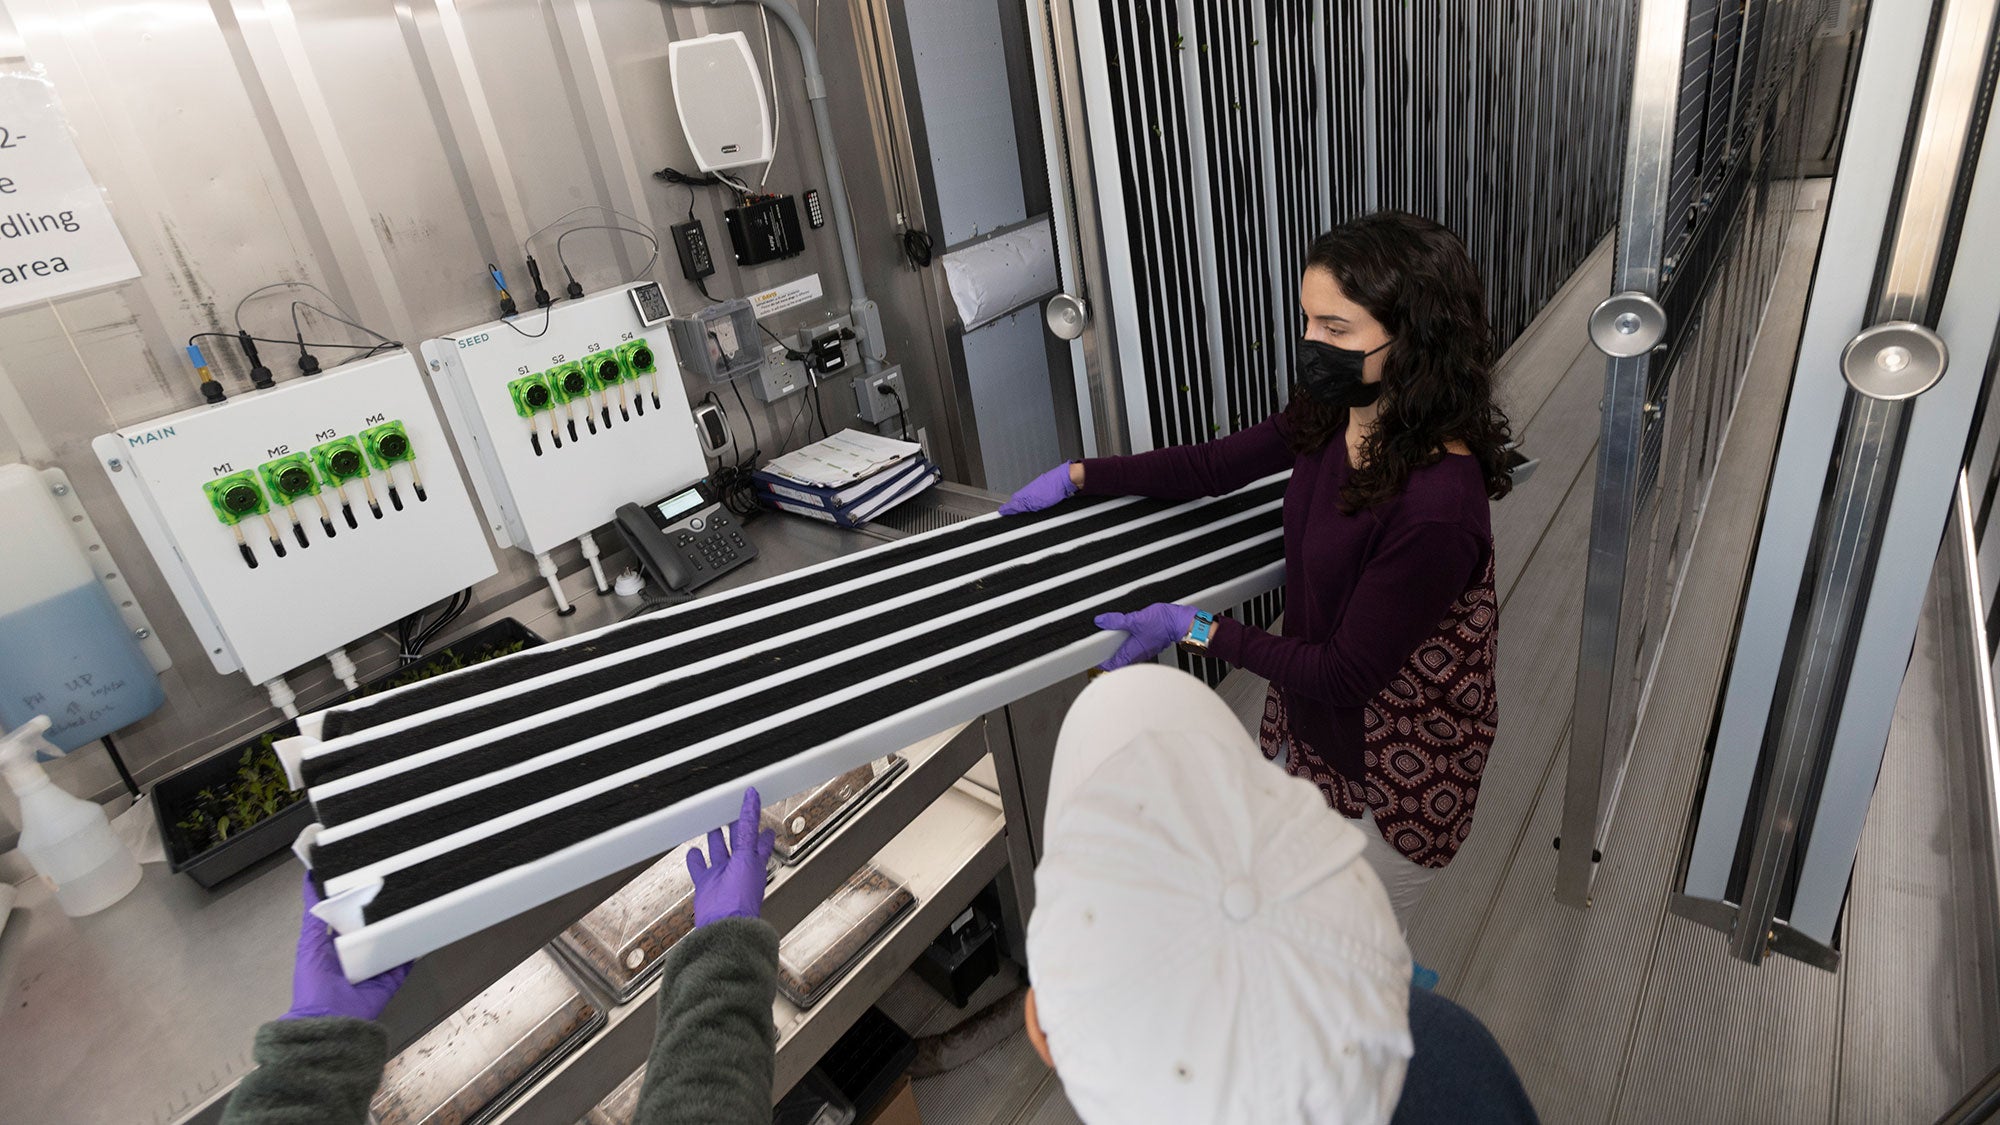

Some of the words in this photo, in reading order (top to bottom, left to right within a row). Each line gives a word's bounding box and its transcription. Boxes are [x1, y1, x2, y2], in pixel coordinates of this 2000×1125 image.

[0, 257, 70, 284] area
[458, 332, 490, 350] SEED
[517, 365, 530, 376] S1
[552, 354, 565, 364] S2
[587, 342, 601, 353] S3
[621, 331, 634, 342] S4
[128, 426, 177, 448] MAIN
[213, 462, 234, 477] M1
[267, 444, 291, 459] M2
[315, 428, 337, 443] M3
[365, 412, 386, 427] M4
